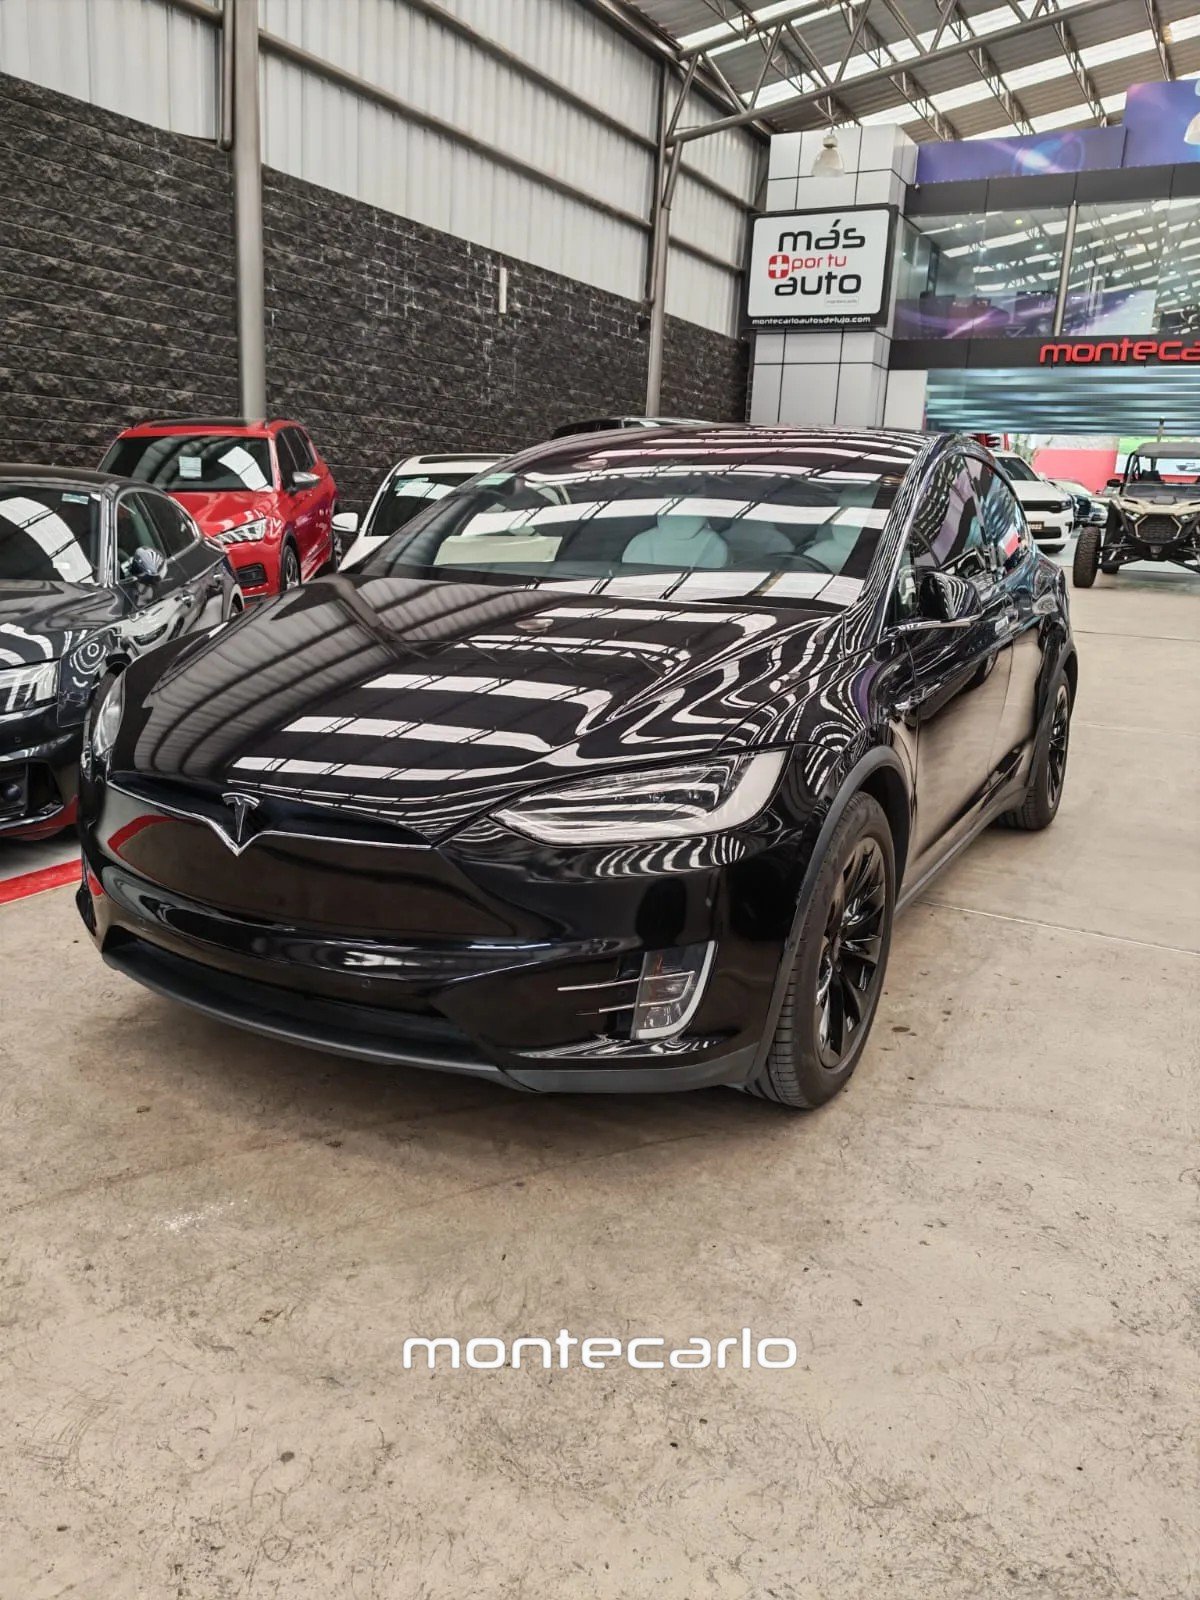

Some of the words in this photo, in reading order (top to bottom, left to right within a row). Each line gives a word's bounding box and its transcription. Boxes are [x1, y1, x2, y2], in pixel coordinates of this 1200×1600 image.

[778, 219, 866, 252] más
[791, 256, 824, 272] por
[828, 253, 847, 268] tu
[774, 271, 862, 296] auto
[752, 316, 871, 325] montecarloautosdelujo.com
